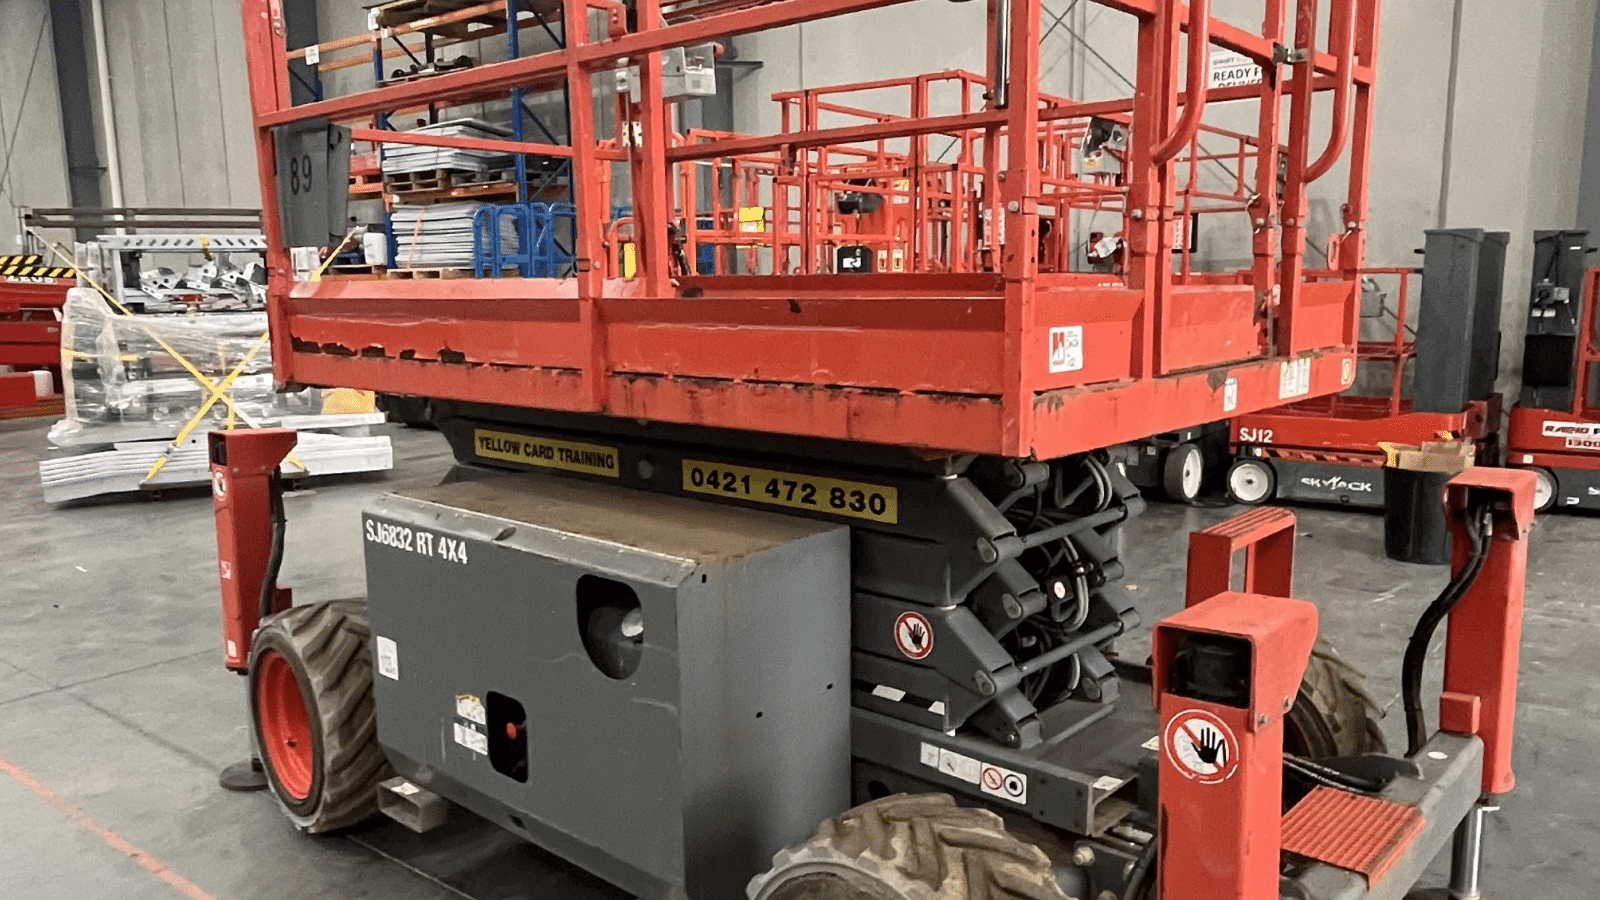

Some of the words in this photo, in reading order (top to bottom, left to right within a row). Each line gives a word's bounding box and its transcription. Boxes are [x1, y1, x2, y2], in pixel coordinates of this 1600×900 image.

[1213, 67, 1251, 81] READY
[290, 154, 313, 195] 89
[478, 436, 521, 455] YELLOW
[523, 443, 554, 460] CARD
[558, 447, 614, 469] TRAINING
[1239, 427, 1273, 443] SJ12
[690, 467, 750, 494] 0421
[765, 478, 817, 505] 472
[829, 487, 886, 515] 830
[365, 519, 414, 552] SJ6832
[416, 531, 434, 557] RT
[437, 536, 468, 565] 4X4
